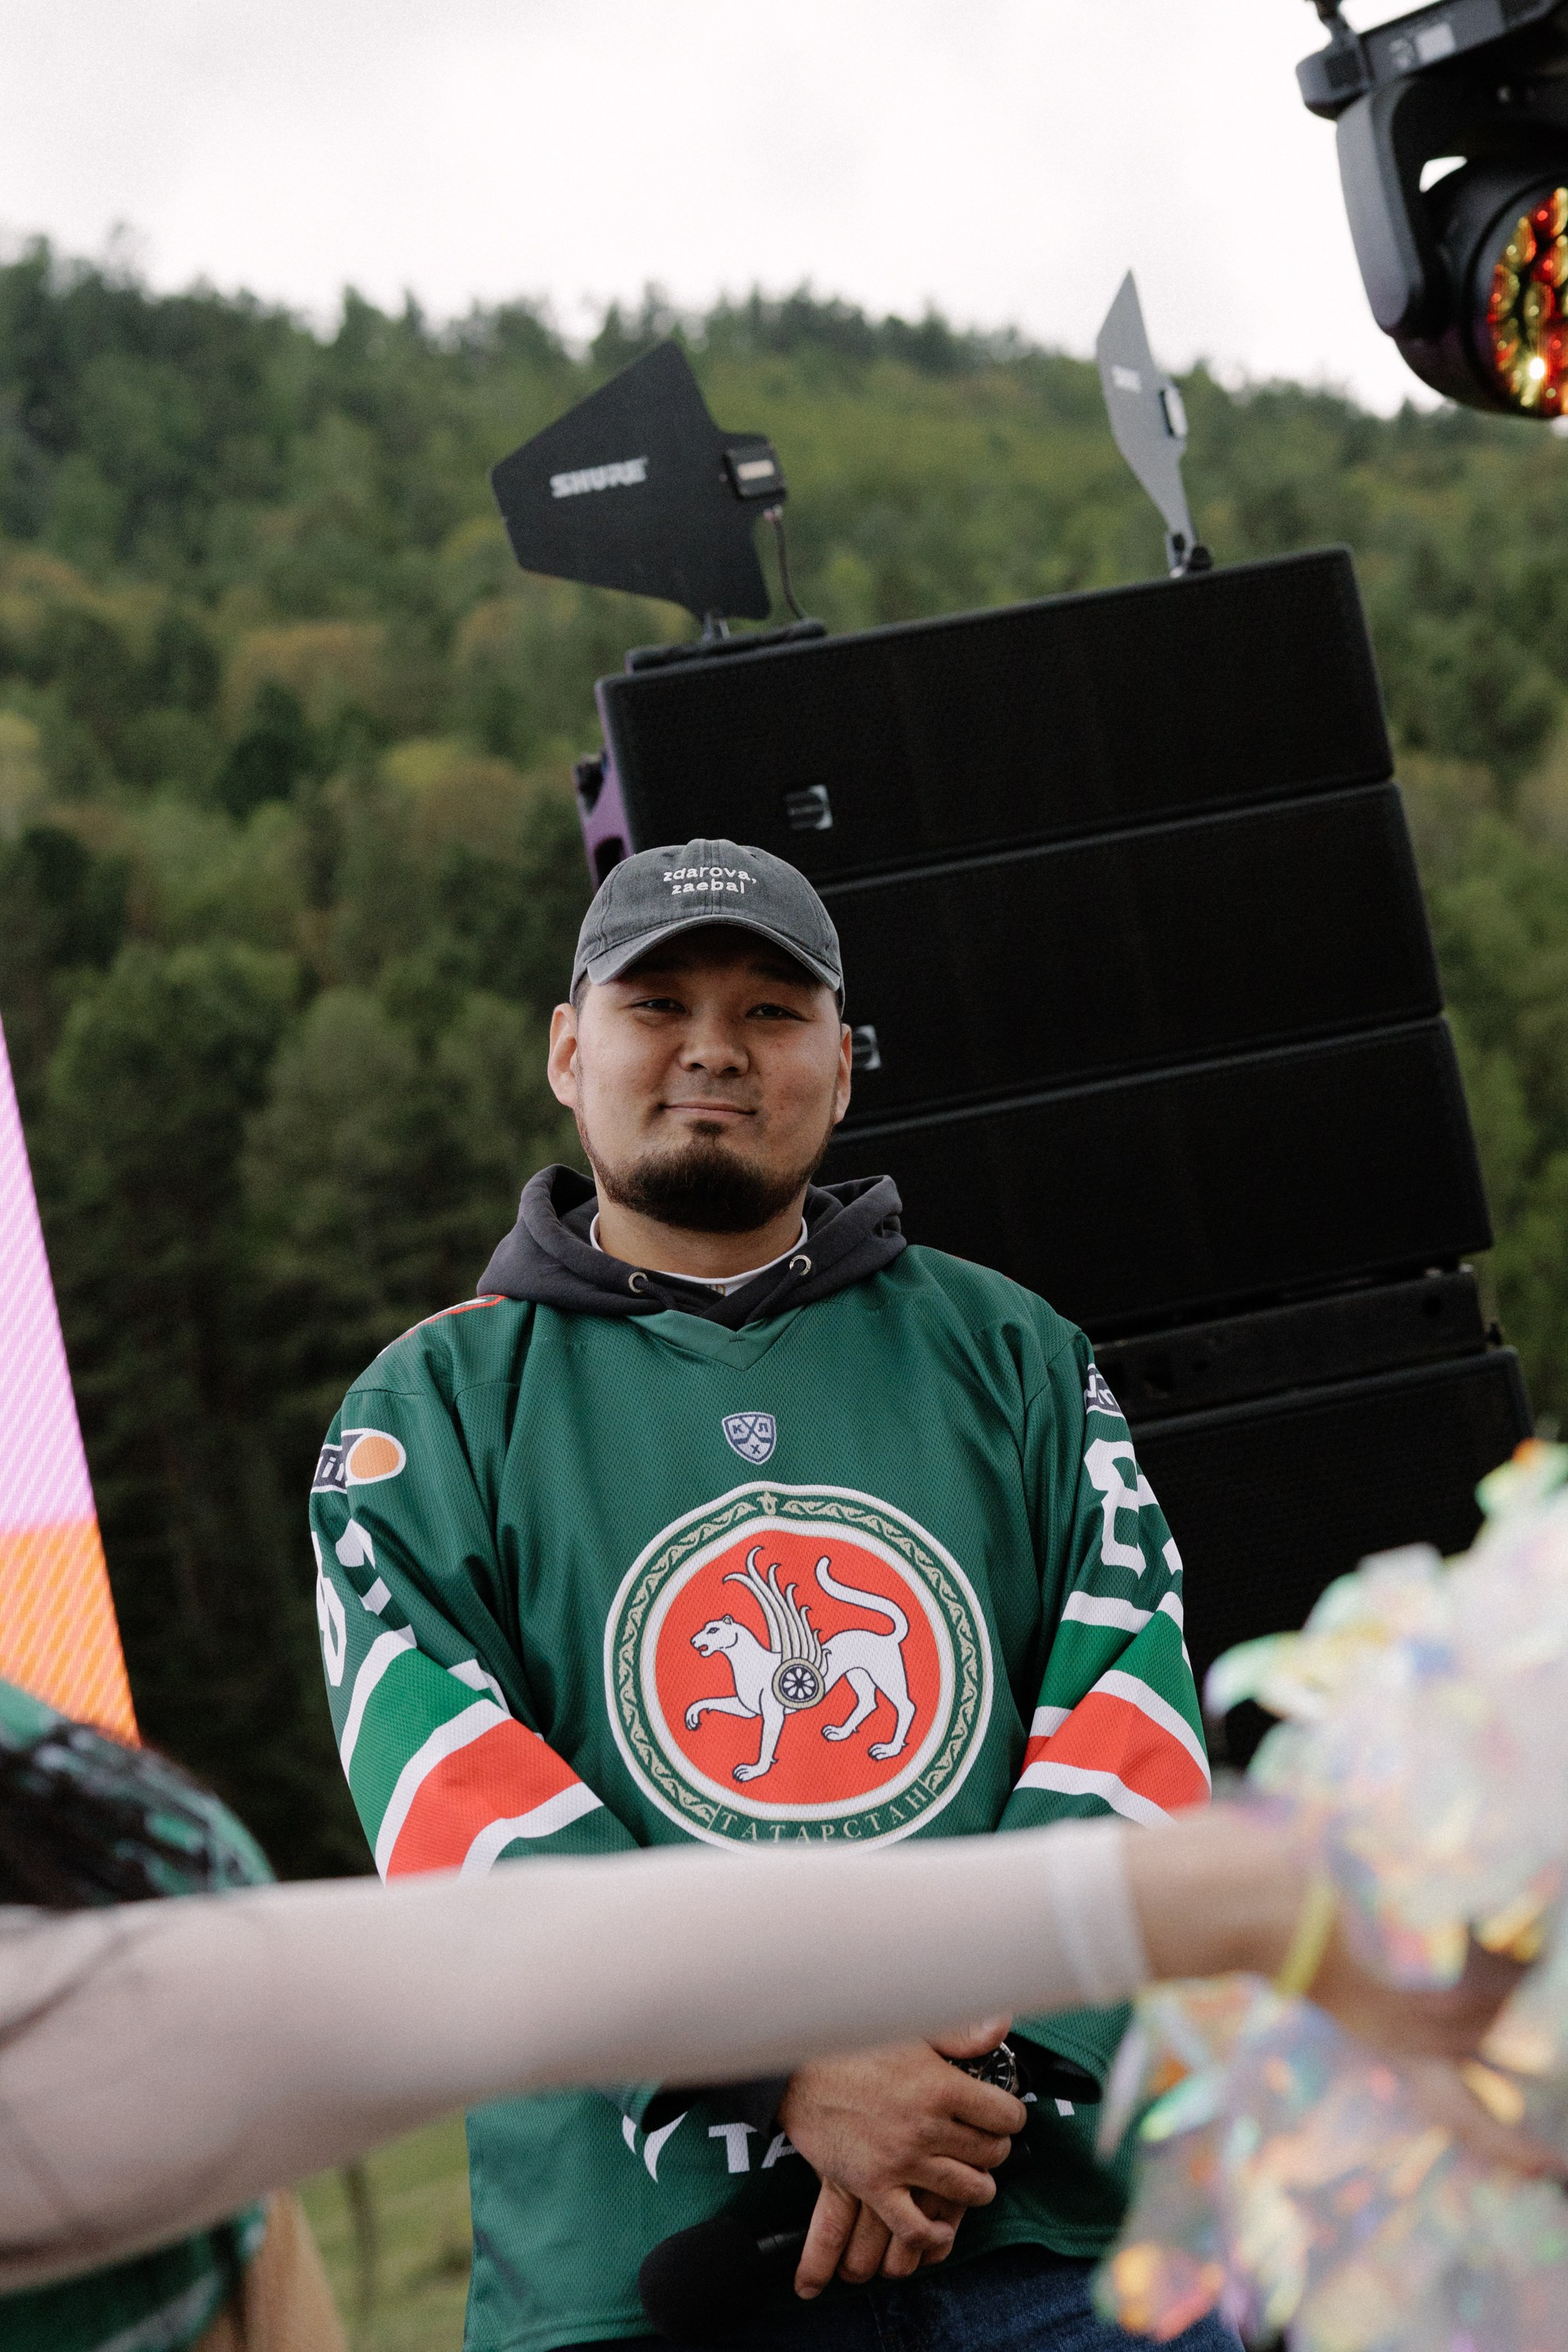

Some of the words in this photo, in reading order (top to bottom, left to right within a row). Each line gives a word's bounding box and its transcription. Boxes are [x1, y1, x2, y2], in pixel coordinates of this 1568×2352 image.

[663, 866, 757, 884] zdarova,
[671, 878, 745, 895] zaebal
[720, 1787, 927, 1845] ТАТАРСТАН
